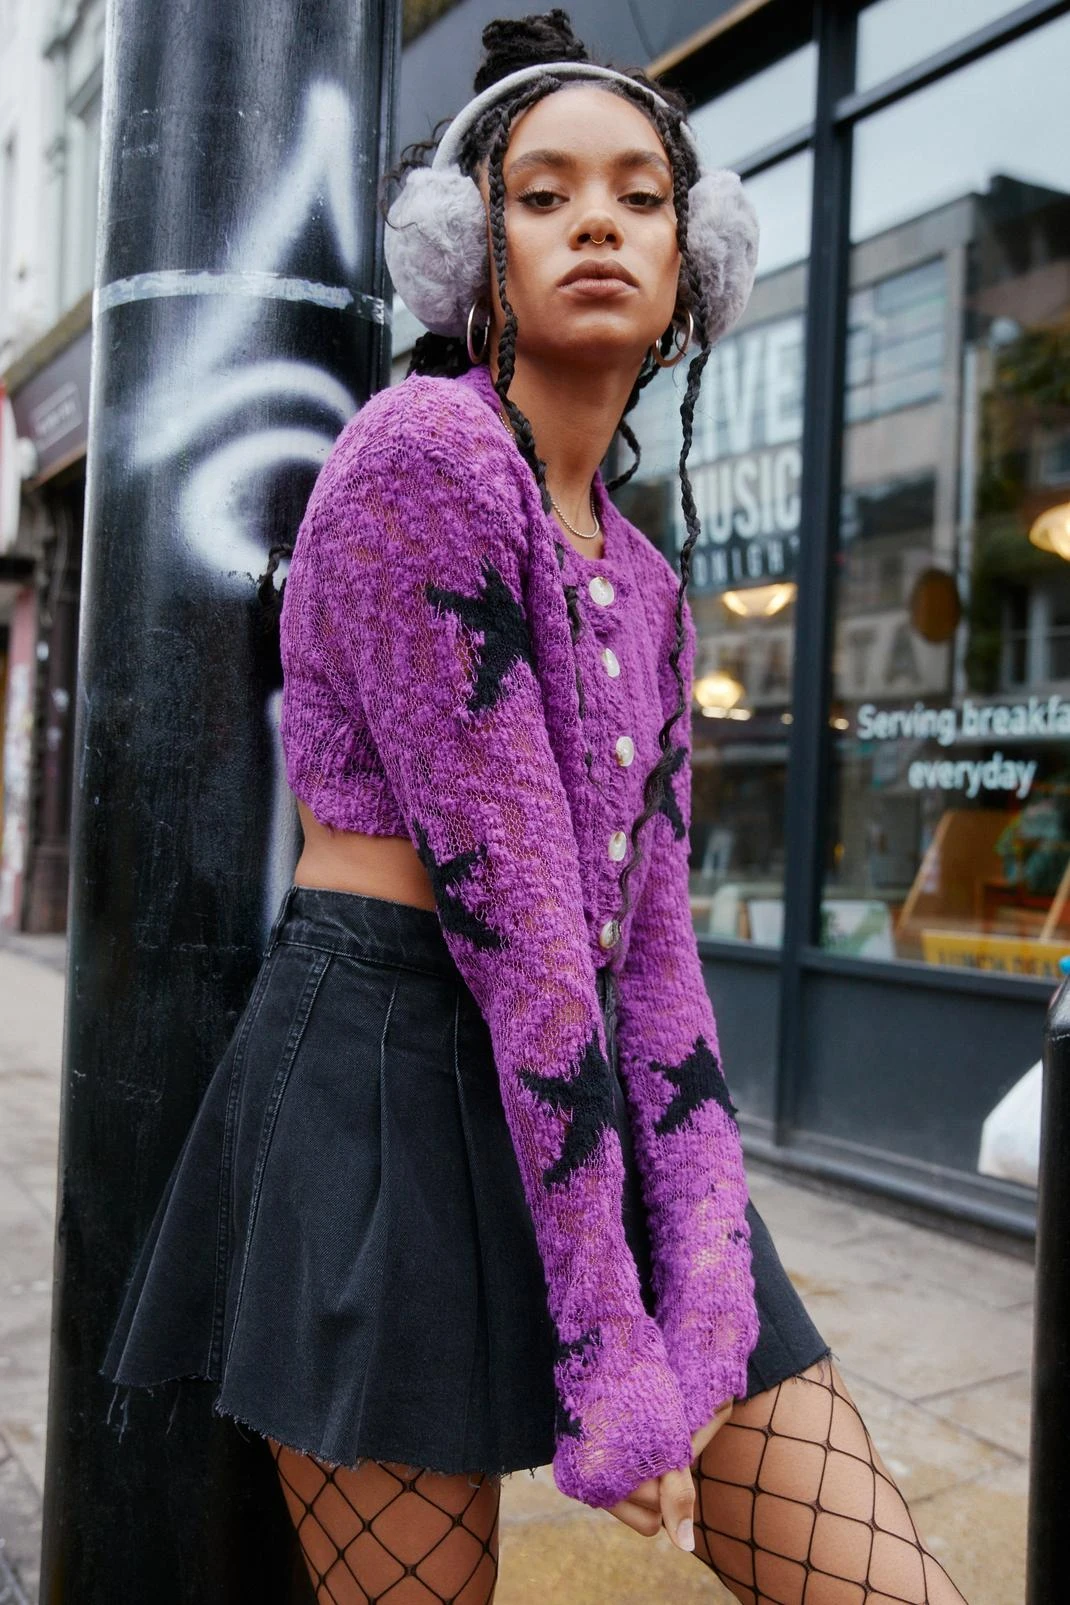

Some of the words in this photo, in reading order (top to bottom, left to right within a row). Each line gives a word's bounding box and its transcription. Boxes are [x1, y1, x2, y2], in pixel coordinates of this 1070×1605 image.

[674, 449, 803, 551] MUSIC
[857, 702, 957, 746] Serving
[908, 751, 1037, 799] everyday
